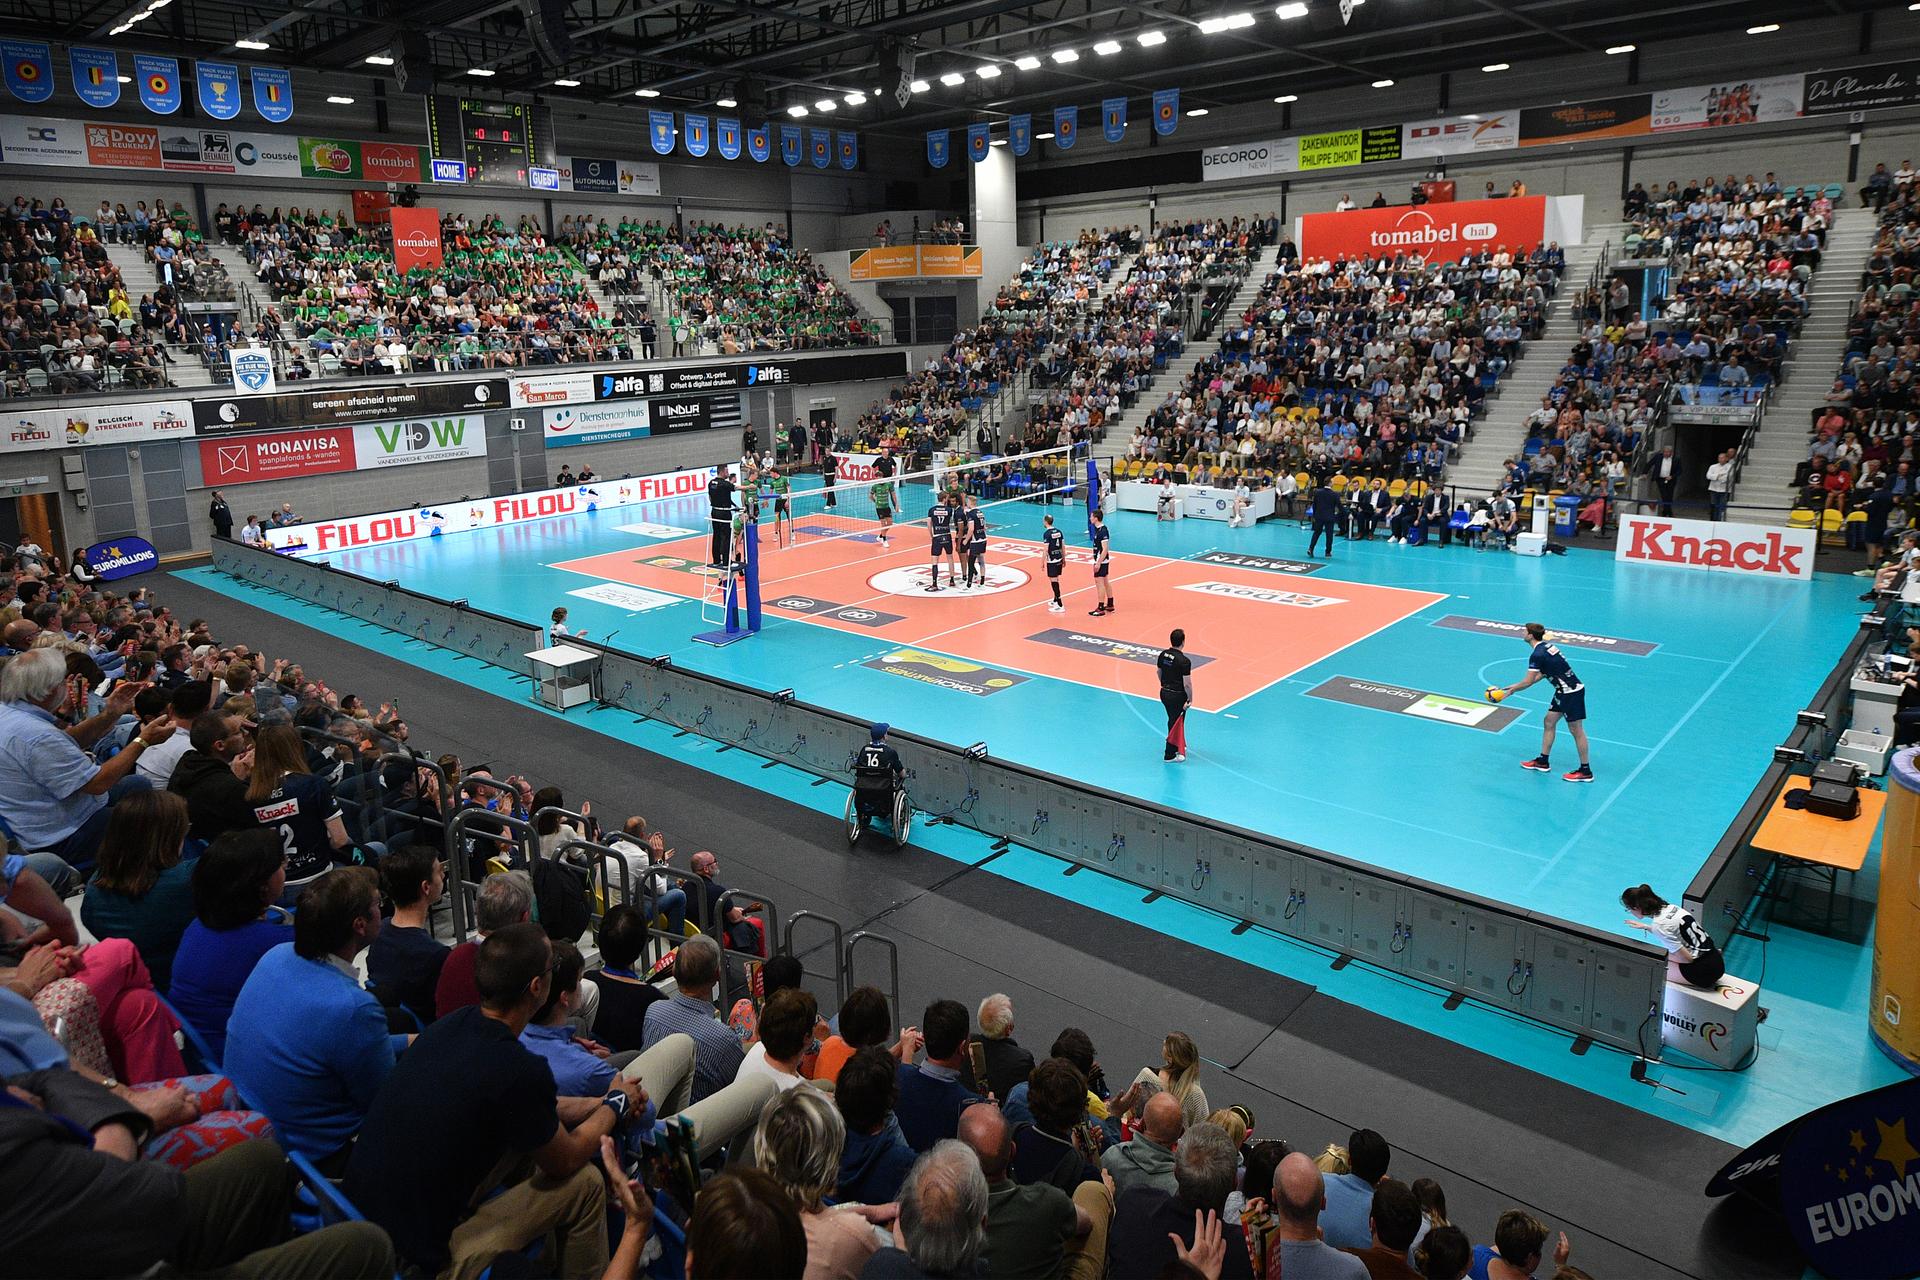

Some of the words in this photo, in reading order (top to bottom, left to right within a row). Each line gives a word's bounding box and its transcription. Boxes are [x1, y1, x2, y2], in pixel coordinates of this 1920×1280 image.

[462, 101, 468, 111] H
[515, 106, 521, 116] G
[1411, 117, 1505, 139] DEX
[111, 129, 157, 150] Dovy
[1302, 134, 1358, 150] ZAKENKANTOOR
[204, 152, 229, 161] DELHAIZE
[261, 152, 298, 161] coussée
[367, 154, 415, 168] tomabel
[1204, 148, 1268, 166] DECOROO
[1302, 153, 1332, 166] PHILIPPE
[1333, 150, 1358, 163] DHONT
[437, 164, 460, 178] HOME
[532, 172, 556, 187] GUEST
[575, 178, 616, 186] AUTOMOBILIA
[1370, 223, 1457, 247] tomabel
[1470, 226, 1489, 237] hal
[398, 238, 438, 248] tomabel
[758, 367, 782, 381] alfa
[615, 376, 644, 392] alfa
[670, 381, 686, 390] Offset
[693, 380, 713, 388] digitaal
[714, 378, 736, 386] drukwerk
[312, 400, 344, 409] sereen
[347, 396, 384, 407] afscheid
[387, 394, 415, 402] nemen
[528, 394, 542, 403] San
[545, 392, 566, 400] Marco
[335, 408, 397, 418] www.commeyne.be
[579, 408, 644, 422] Dienstenaanhuis
[667, 404, 700, 416] INDUR
[95, 421, 144, 431] STREKENBIER
[98, 416, 133, 424] BELGISCH
[153, 419, 187, 430] FILOU
[10, 430, 50, 442] FILOU
[375, 418, 466, 453] VDW
[582, 432, 631, 442] DIENSTENCHEQUES
[257, 437, 339, 456] MONAVISA
[259, 453, 306, 464] spanplafonds
[377, 456, 422, 465] VANDENWEGHE
[423, 451, 470, 460] VERZEKERINGEN
[639, 473, 706, 500] FILOU
[493, 492, 574, 523] FILOU
[937, 516, 945, 524] 17
[315, 515, 417, 550] FILOU
[1625, 521, 1803, 574] Knack
[93, 550, 154, 572] EUROMILLIONS
[1205, 555, 1305, 572] SAMYN
[1194, 583, 1279, 600] Dovy
[866, 754, 879, 767] 16
[256, 802, 296, 821] Knack
[280, 823, 297, 855] 2
[1664, 1013, 1697, 1033] VOLLEY
